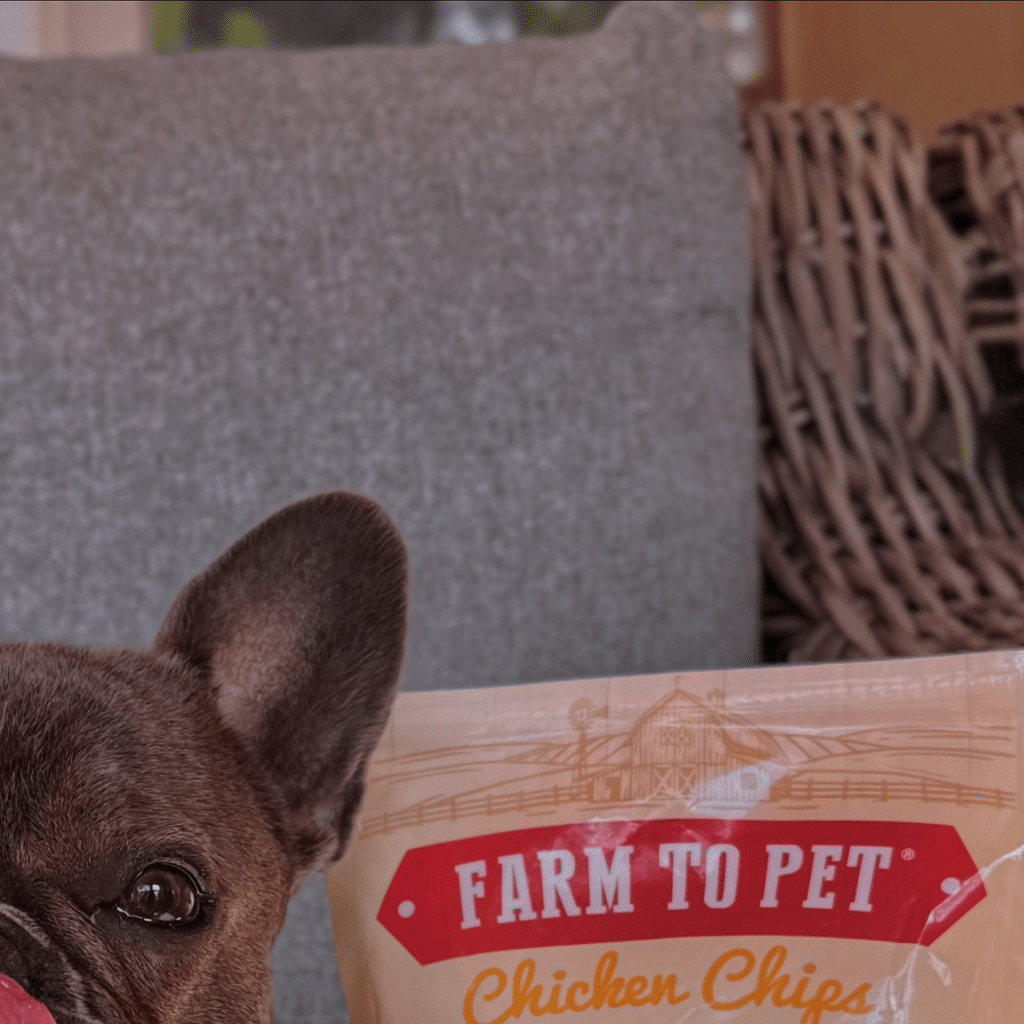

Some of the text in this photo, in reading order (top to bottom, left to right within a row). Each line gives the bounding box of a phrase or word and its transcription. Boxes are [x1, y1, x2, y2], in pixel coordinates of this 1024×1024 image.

[454, 841, 894, 931] FARM TO PET
